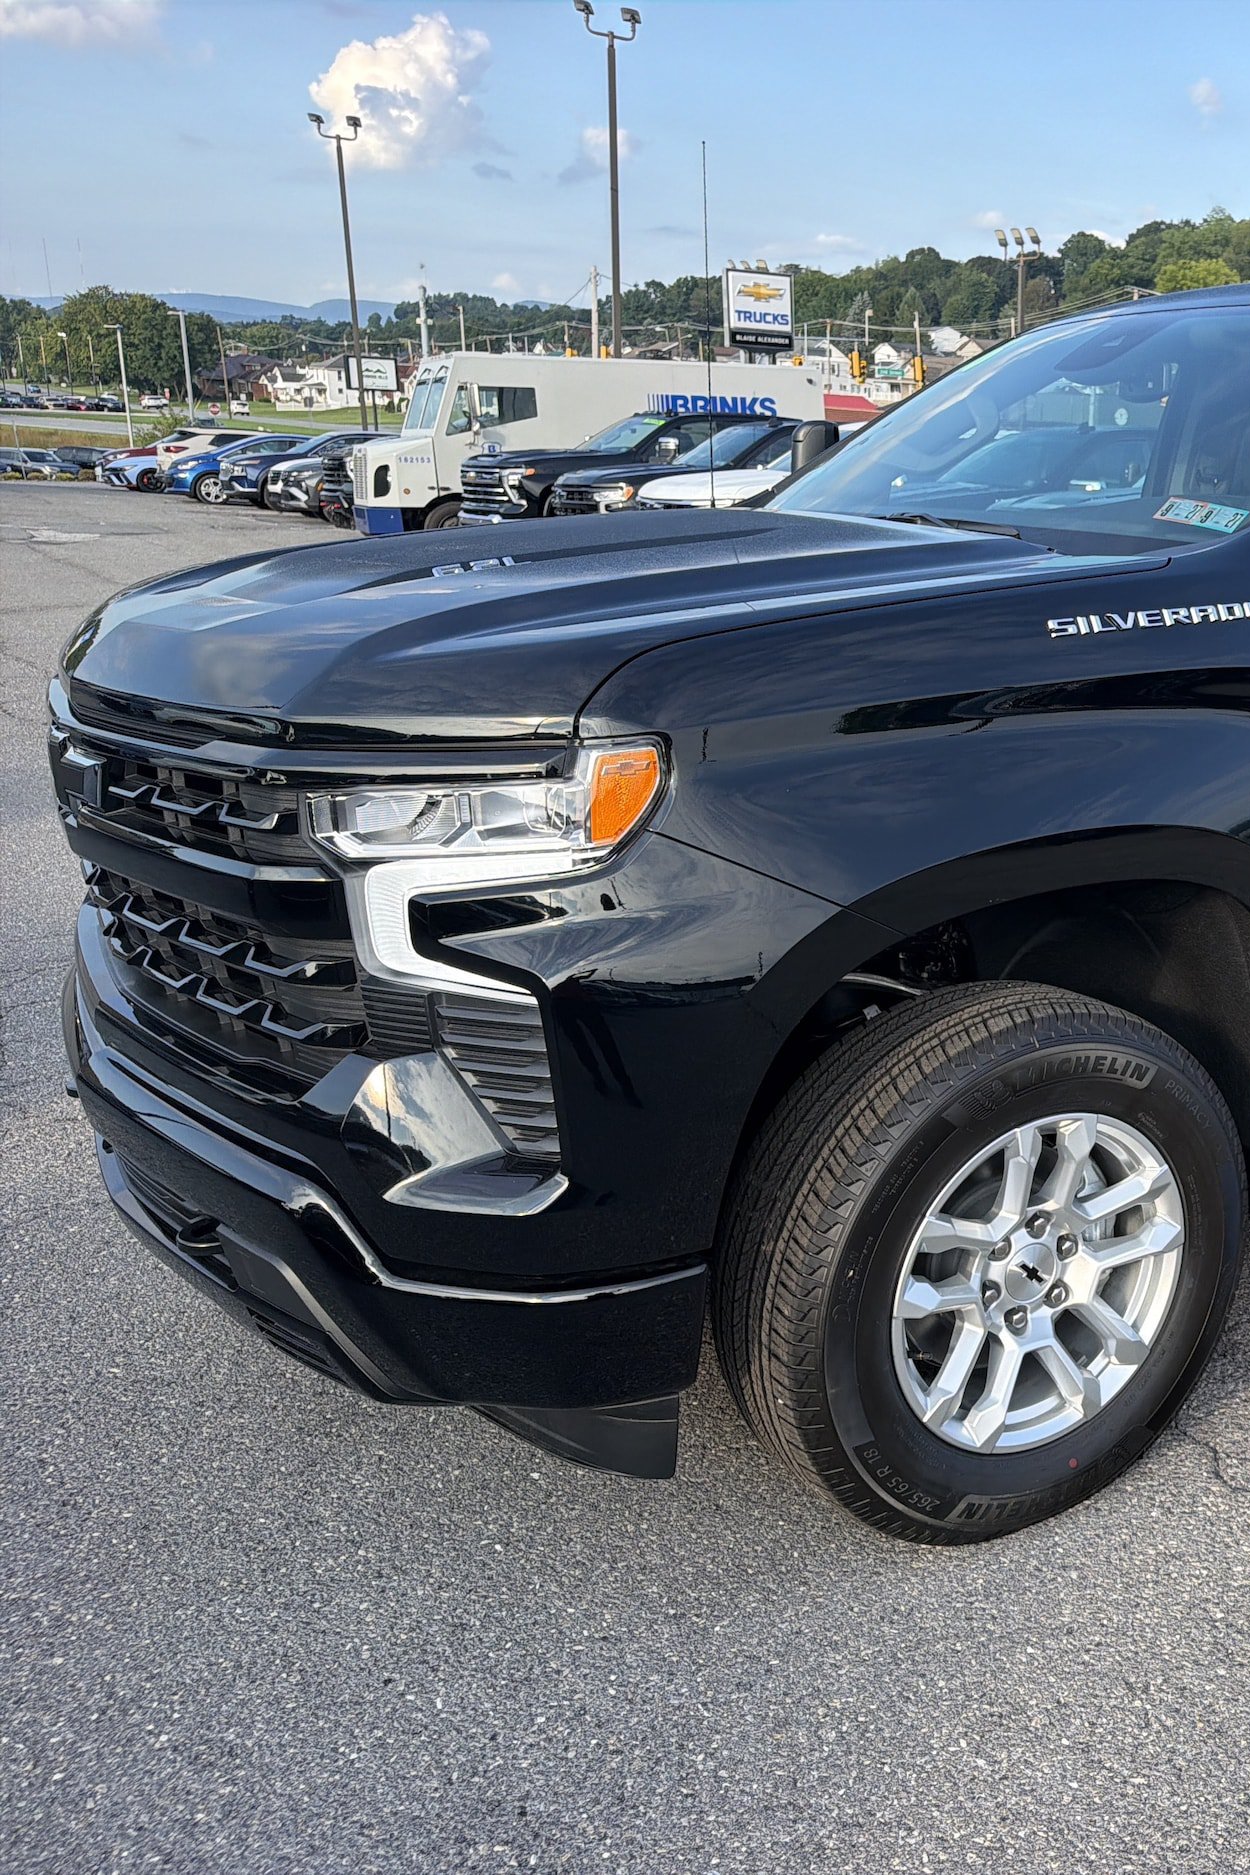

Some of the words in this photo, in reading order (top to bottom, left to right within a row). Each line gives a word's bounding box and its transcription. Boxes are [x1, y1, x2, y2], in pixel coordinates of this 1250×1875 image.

[735, 309, 789, 326] TRUCKS
[735, 334, 757, 343] BLAISE
[757, 335, 790, 345] ALEXANDER
[669, 394, 778, 417] BRINKS
[1016, 1055, 1151, 1093] MICHELIN
[1164, 1079, 1213, 1130] PRIMACY
[863, 1447, 882, 1466] 18
[876, 1463, 893, 1478] R
[887, 1475, 941, 1512] 265/65
